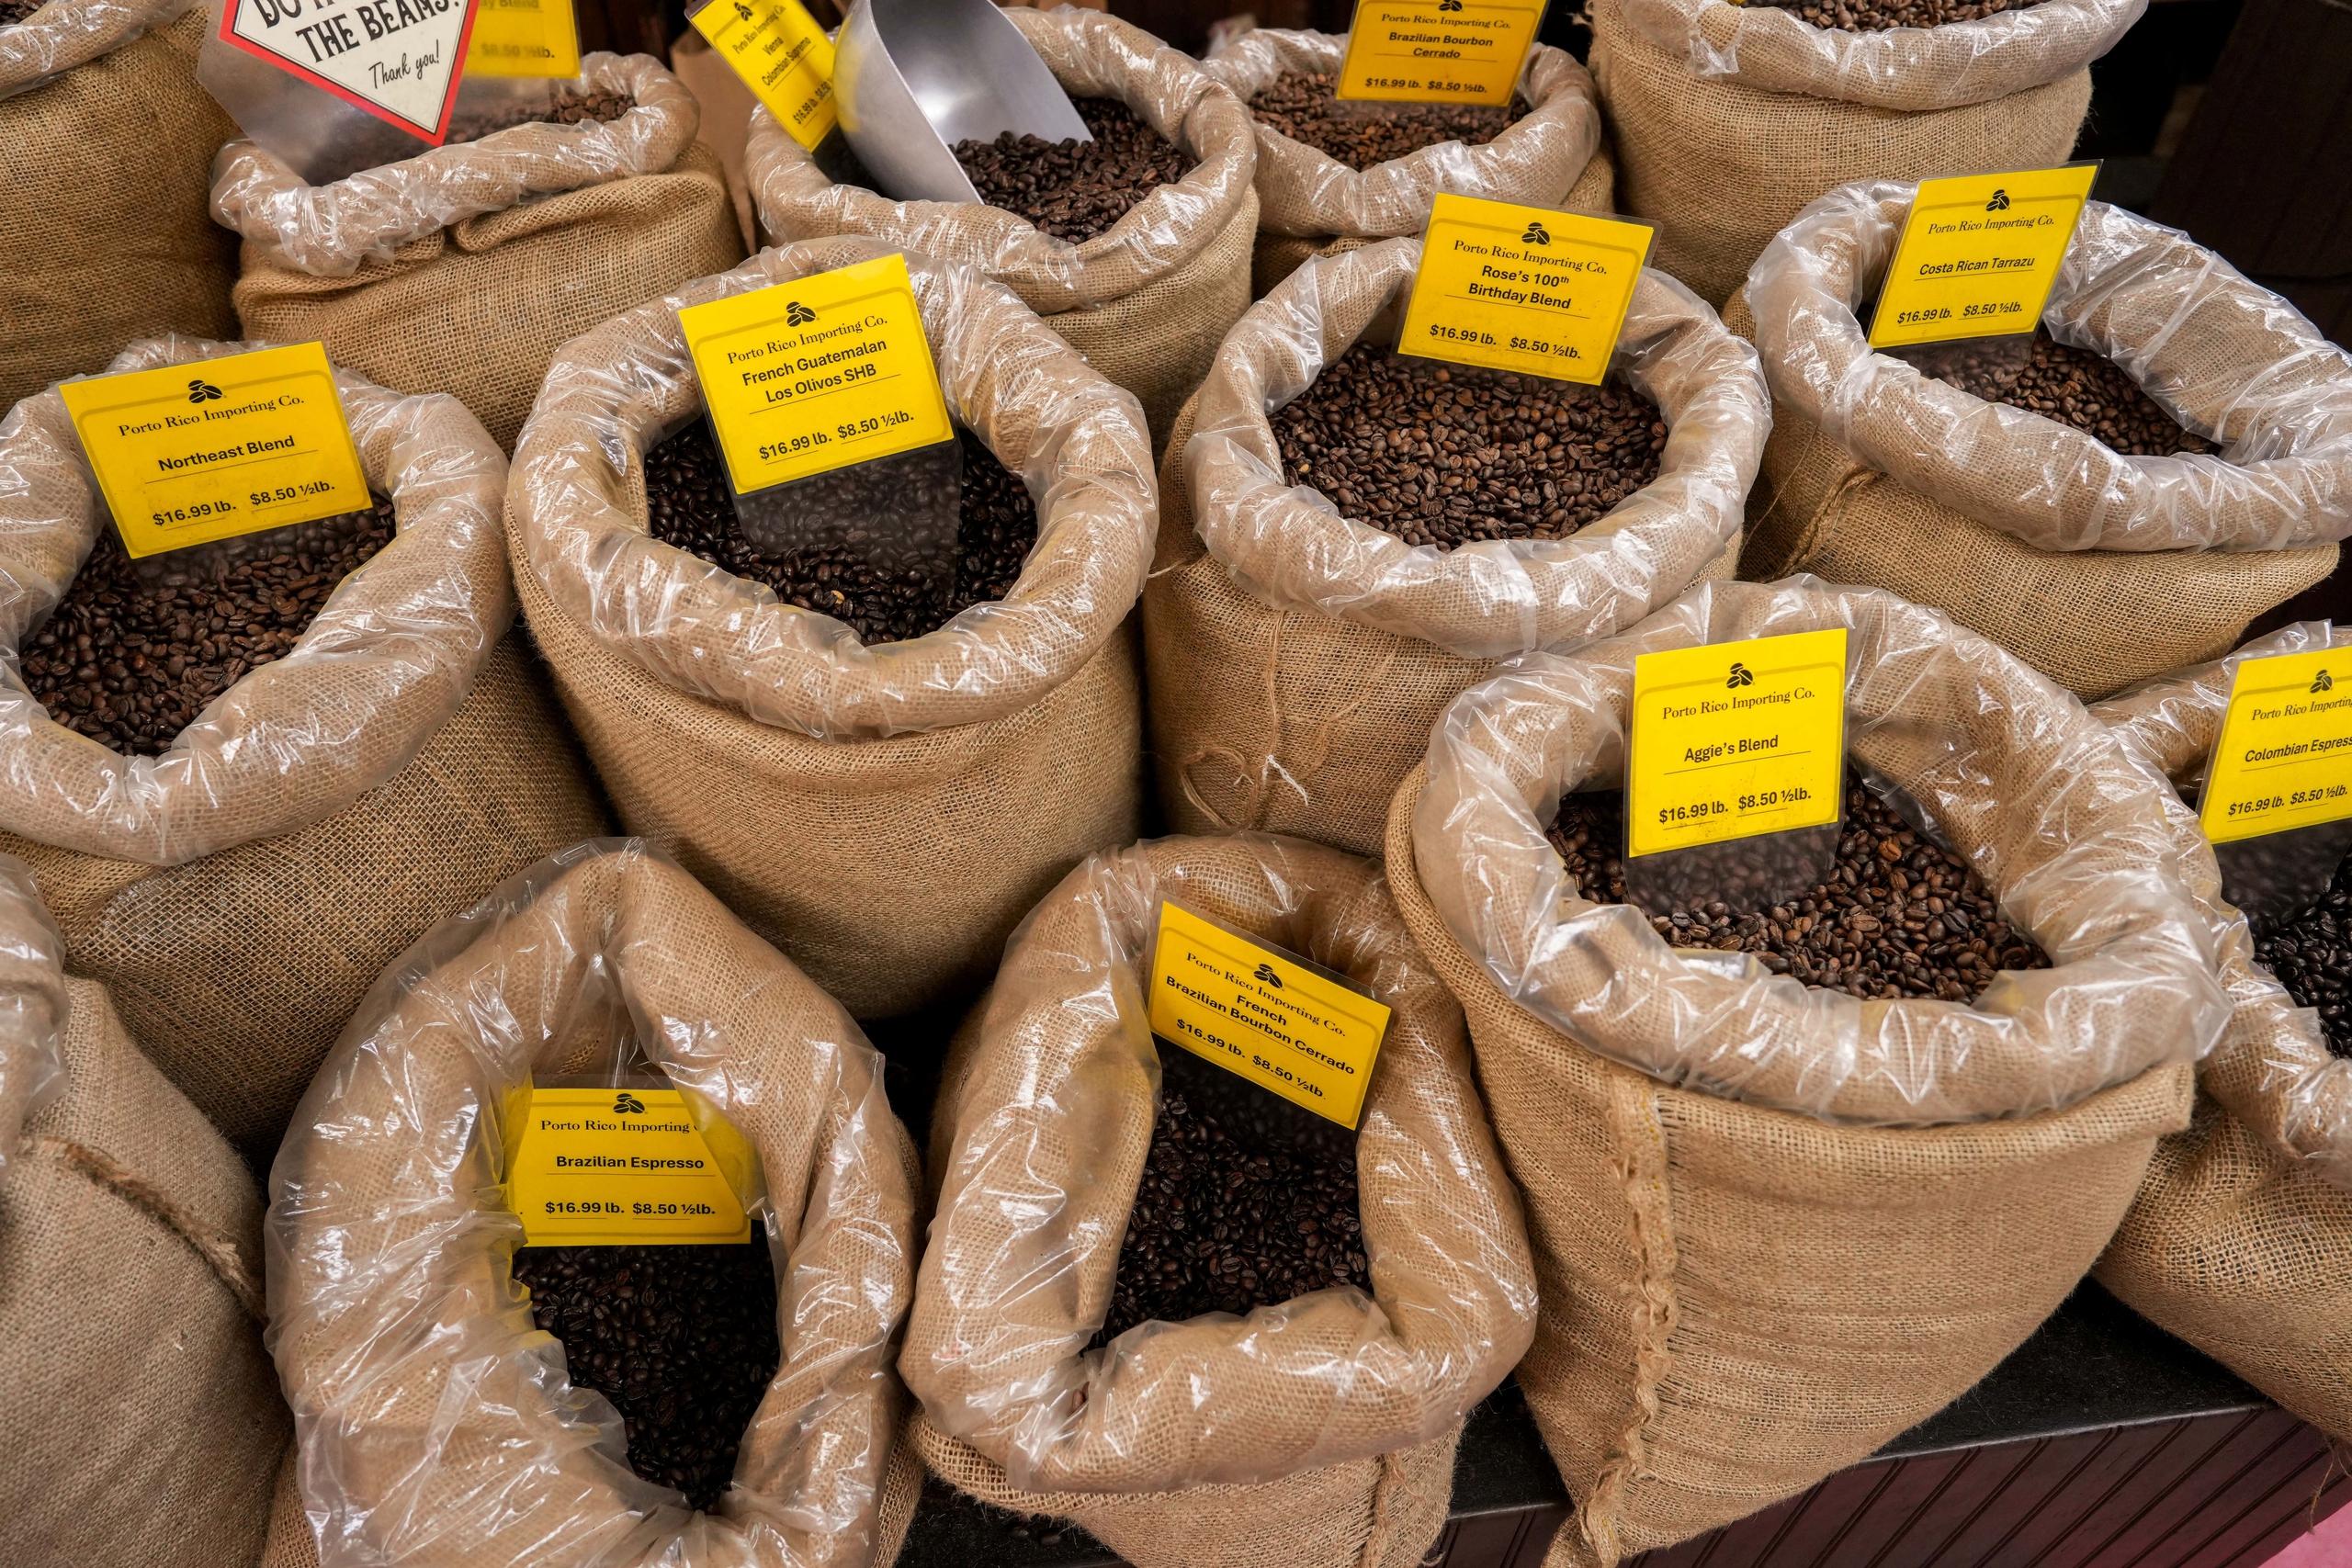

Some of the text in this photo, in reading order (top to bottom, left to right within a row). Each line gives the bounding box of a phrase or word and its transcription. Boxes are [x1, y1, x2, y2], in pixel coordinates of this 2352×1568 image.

[295, 0, 459, 63] THE BEAN
[732, 39, 749, 54] Porto
[744, 30, 758, 44] Rico
[753, 11, 779, 35] Importing
[1381, 14, 1510, 28] Porto Rico Importing Co.
[762, 37, 784, 55] Vienna
[1389, 32, 1493, 47] Brazilian Bourbon
[1413, 48, 1461, 59] Cerrado
[368, 39, 439, 89] Thank you!
[762, 37, 811, 85] Colombian Supremo
[1365, 78, 1487, 93] $16.99 lb. $8.50 ½lb.
[793, 102, 812, 124] $16.99
[1928, 214, 2054, 234] Porto Rico Importing Co.
[1453, 240, 1607, 274] Porto Rico Importing Co.
[1482, 265, 1530, 281] Rose’s
[1919, 256, 2035, 276] Costa Rican Tarrazu
[1468, 283, 1571, 309] Birthday Blend
[1897, 302, 2023, 323] $16.99 lb. $8.50 ½lb.
[728, 314, 888, 364] Porto Rico Importing Co.
[1430, 323, 1581, 358] $16.99 lb. $8.50 ½lb.
[742, 339, 888, 386] French Guatemalan
[765, 364, 876, 402] Los Olivos SHB
[119, 394, 304, 436] Porto Rico Importing Co.
[759, 408, 914, 460] $16.99 lb. $8.50 ½lb.
[157, 435, 296, 471] Northeast Blend
[153, 480, 335, 526] $16.99 lb. $8.50 ½lb.
[1663, 687, 1815, 719] Porto Rico Importing Co.
[2252, 709, 2280, 721] Porto
[2284, 705, 2307, 716] Rico
[1684, 734, 1779, 763] Aggie’s Blend
[2245, 736, 2352, 762] Colombian Espress
[1659, 787, 1812, 824] $16.99 lb. $8.50 ½lb.
[2228, 784, 2348, 816] $16.99 lb. $8.50 ½lb.
[1187, 952, 1346, 1037] Porto Rico Importing Co.
[1237, 995, 1286, 1026] French
[1166, 976, 1354, 1075] Brazilian Bourbon Cerrado
[1176, 1019, 1326, 1100] $16.99 lb. $8.50 ½lb.
[540, 1120, 580, 1131] Porto
[585, 1120, 616, 1131] Rico
[621, 1121, 690, 1134] Importing
[557, 1156, 704, 1170] Brazilian Espresso
[545, 1201, 716, 1215] $16.99 lb. $8.50 ½lb.
